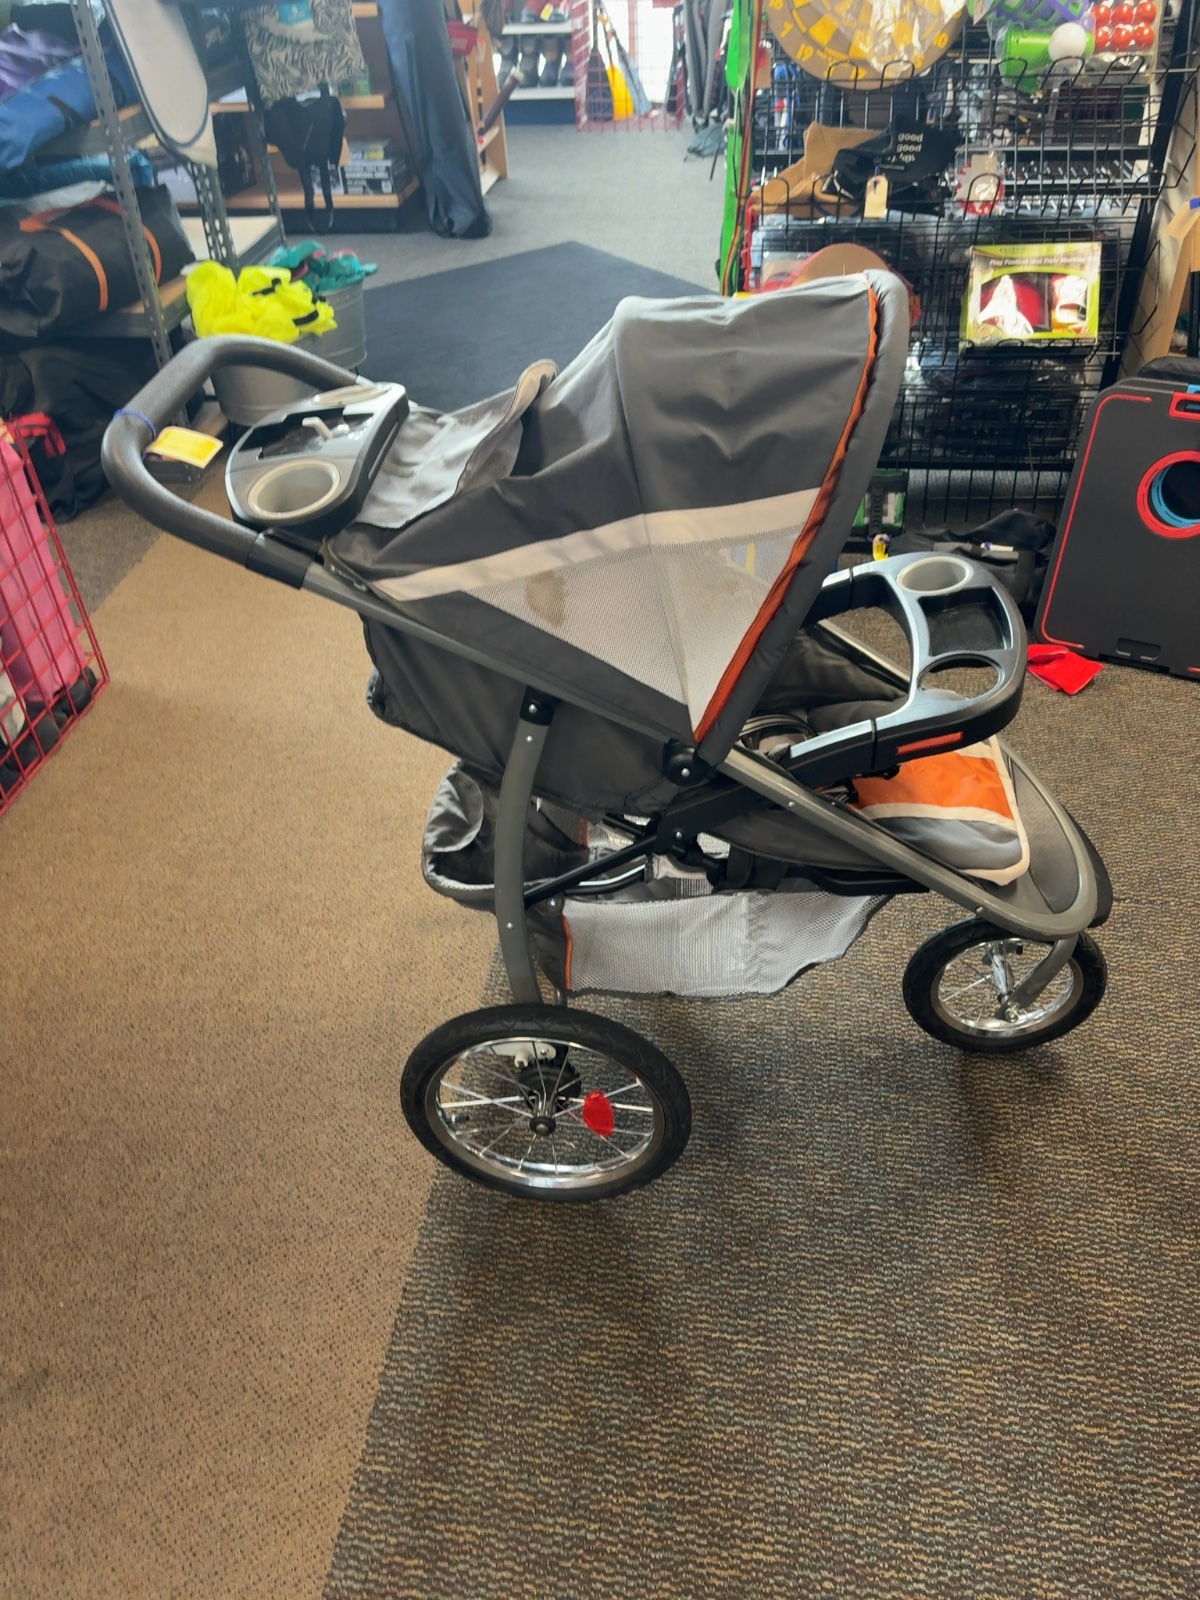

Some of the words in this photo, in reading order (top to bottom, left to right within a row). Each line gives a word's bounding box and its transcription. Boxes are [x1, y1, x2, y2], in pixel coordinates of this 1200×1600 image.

[780, 21, 794, 38] 7
[796, 43, 814, 62] 19
[898, 133, 924, 142] good
[896, 144, 922, 153] good
